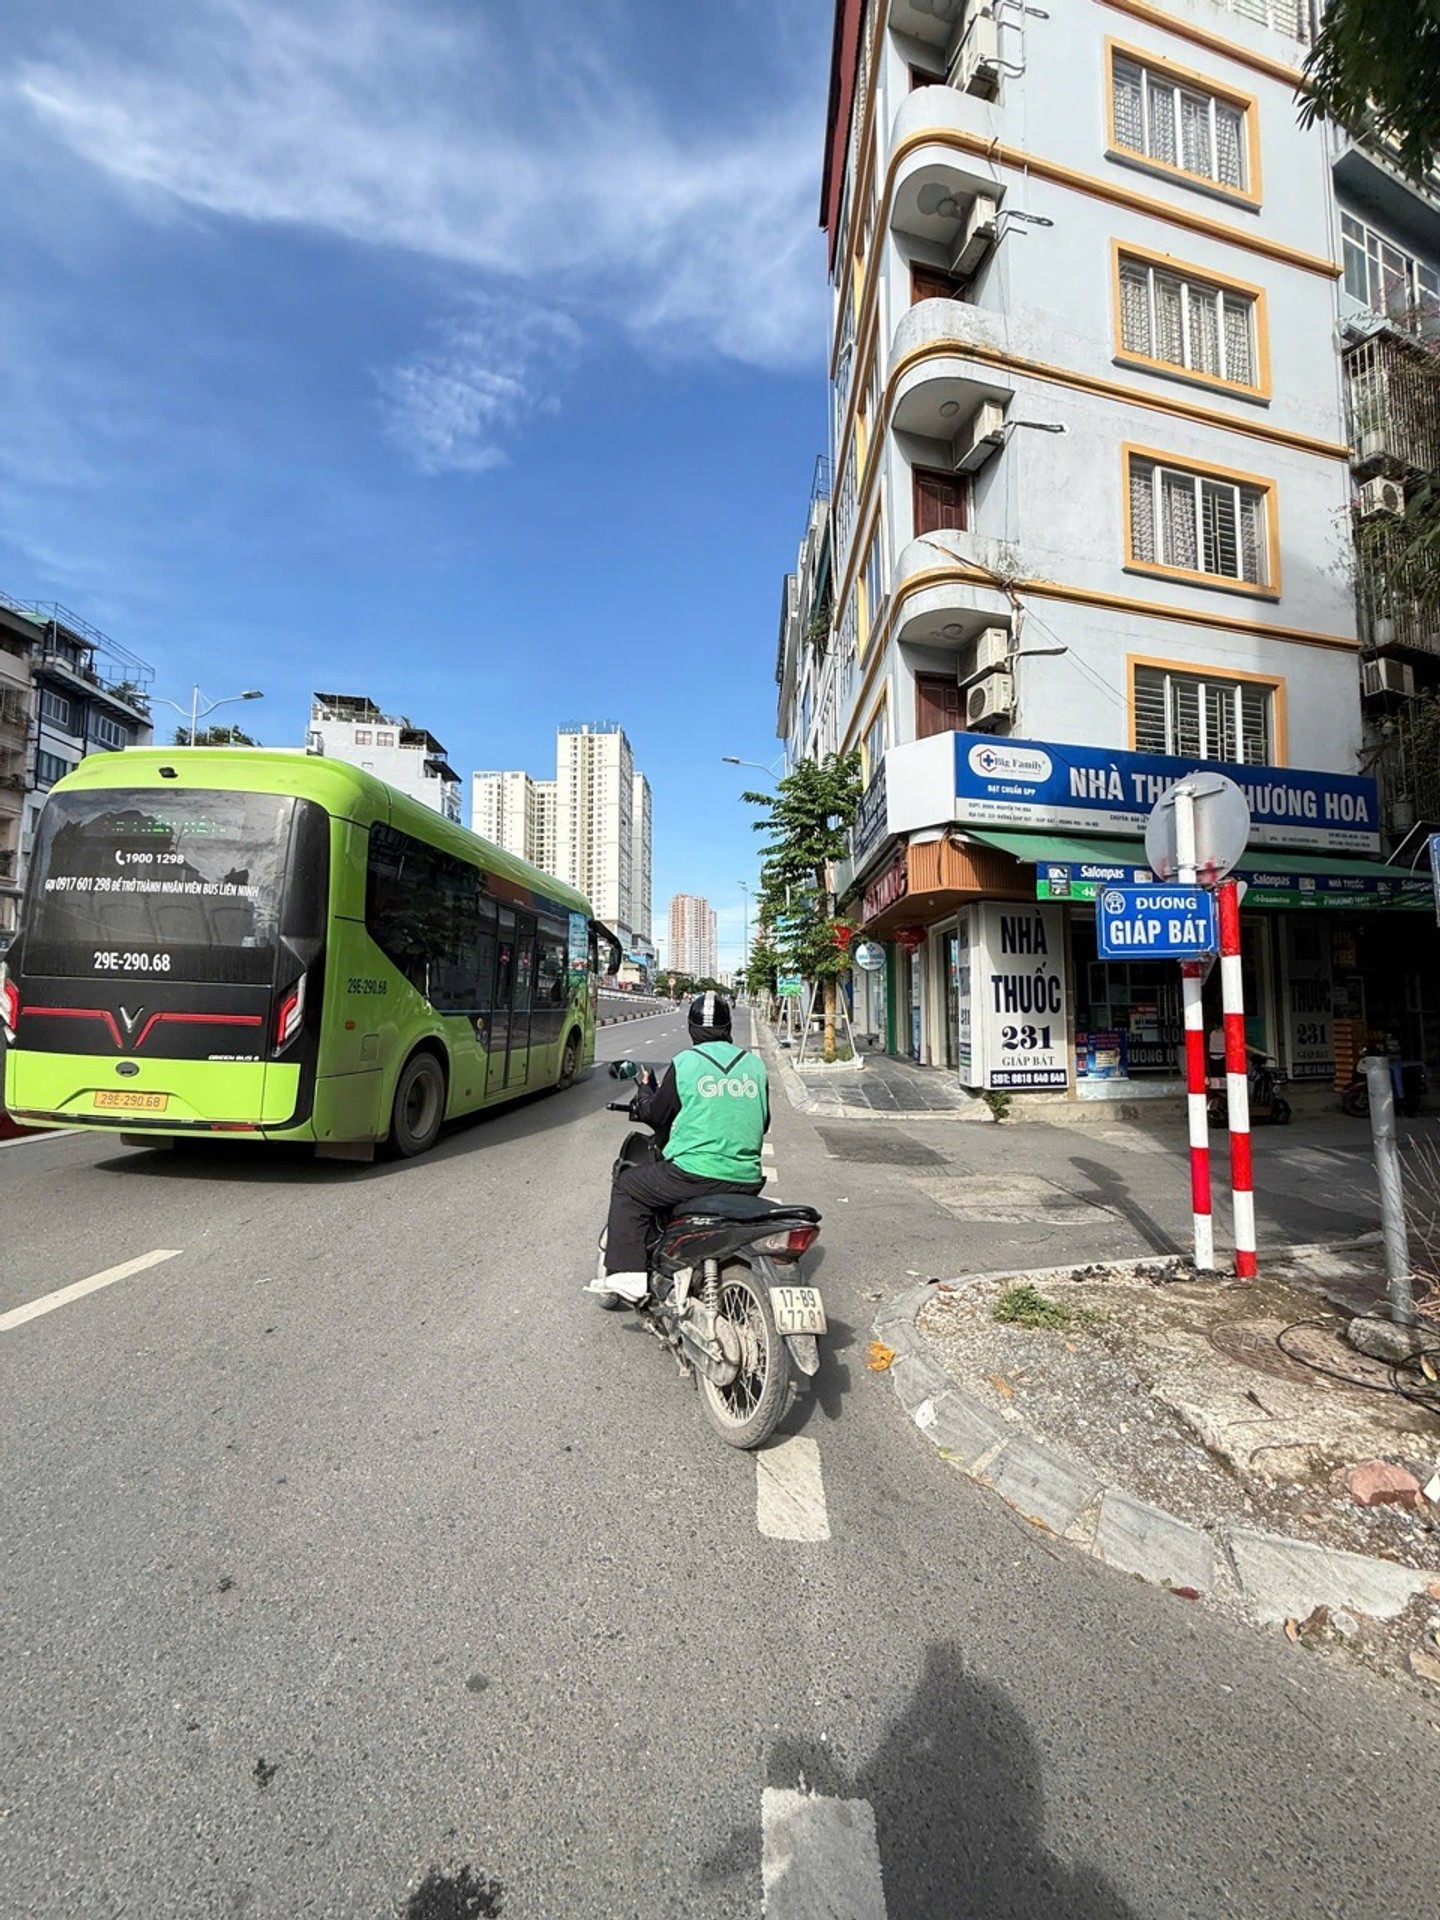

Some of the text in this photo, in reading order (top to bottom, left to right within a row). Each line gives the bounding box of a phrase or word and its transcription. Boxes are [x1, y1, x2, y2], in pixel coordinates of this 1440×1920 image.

[994, 756, 1043, 771] Big Family
[1069, 764, 1124, 801] NHÀ
[1240, 783, 1318, 819] HƯƠNG
[1325, 792, 1369, 823] HOA
[125, 853, 184, 865] 1900 1298
[1081, 865, 1125, 882] Salonpas
[1252, 874, 1290, 888] Salonpas
[56, 876, 77, 891] 0917
[76, 876, 93, 891] 601
[93, 877, 112, 892] 298
[136, 878, 162, 893] THÀNH
[162, 880, 184, 894] NHÂN
[184, 880, 202, 894] VIÊN
[202, 883, 219, 896] BUS
[219, 882, 237, 896] LIÊN
[237, 884, 260, 897] NINH
[1000, 908, 1048, 955] NHÀ
[1110, 913, 1207, 945] GIÁP BÁT
[94, 952, 171, 972] 29E-290.68
[347, 978, 388, 996] 29E-290.68
[990, 961, 1061, 1014] THUỐC
[1002, 1024, 1054, 1050] 231
[1297, 1022, 1327, 1045] 231
[1002, 1053, 1056, 1066] GIÁP BÁT
[698, 1074, 758, 1099] Grab
[100, 1094, 160, 1108] 29E-290.68
[779, 1289, 816, 1308] 17-B9
